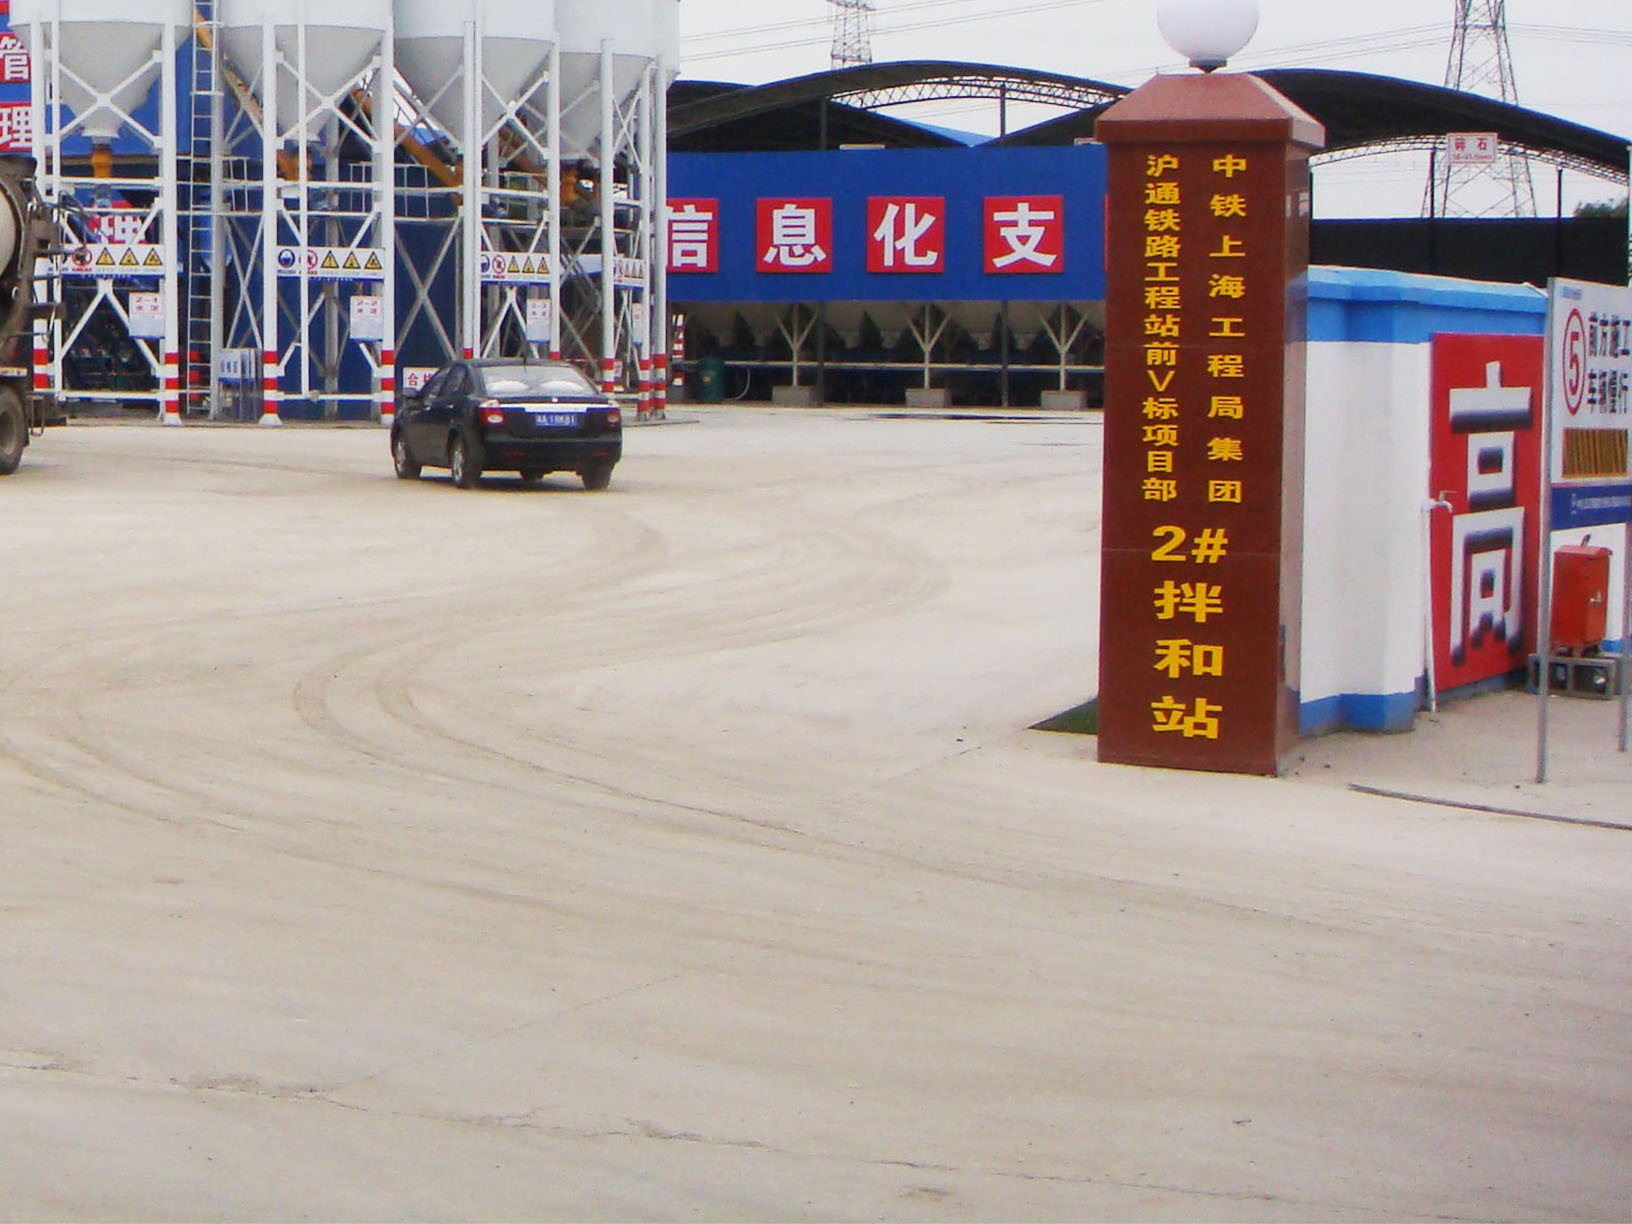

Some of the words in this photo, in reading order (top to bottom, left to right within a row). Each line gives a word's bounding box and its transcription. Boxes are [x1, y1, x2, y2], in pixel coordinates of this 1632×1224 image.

[1142, 154, 1181, 502] 沪通铁路工程站前V标项目部
[1207, 154, 1247, 503] 中铁上海工程局集团
[1570, 331, 1580, 395] 5
[1151, 525, 1229, 563] 2#
[1151, 580, 1224, 740] 拌和站
